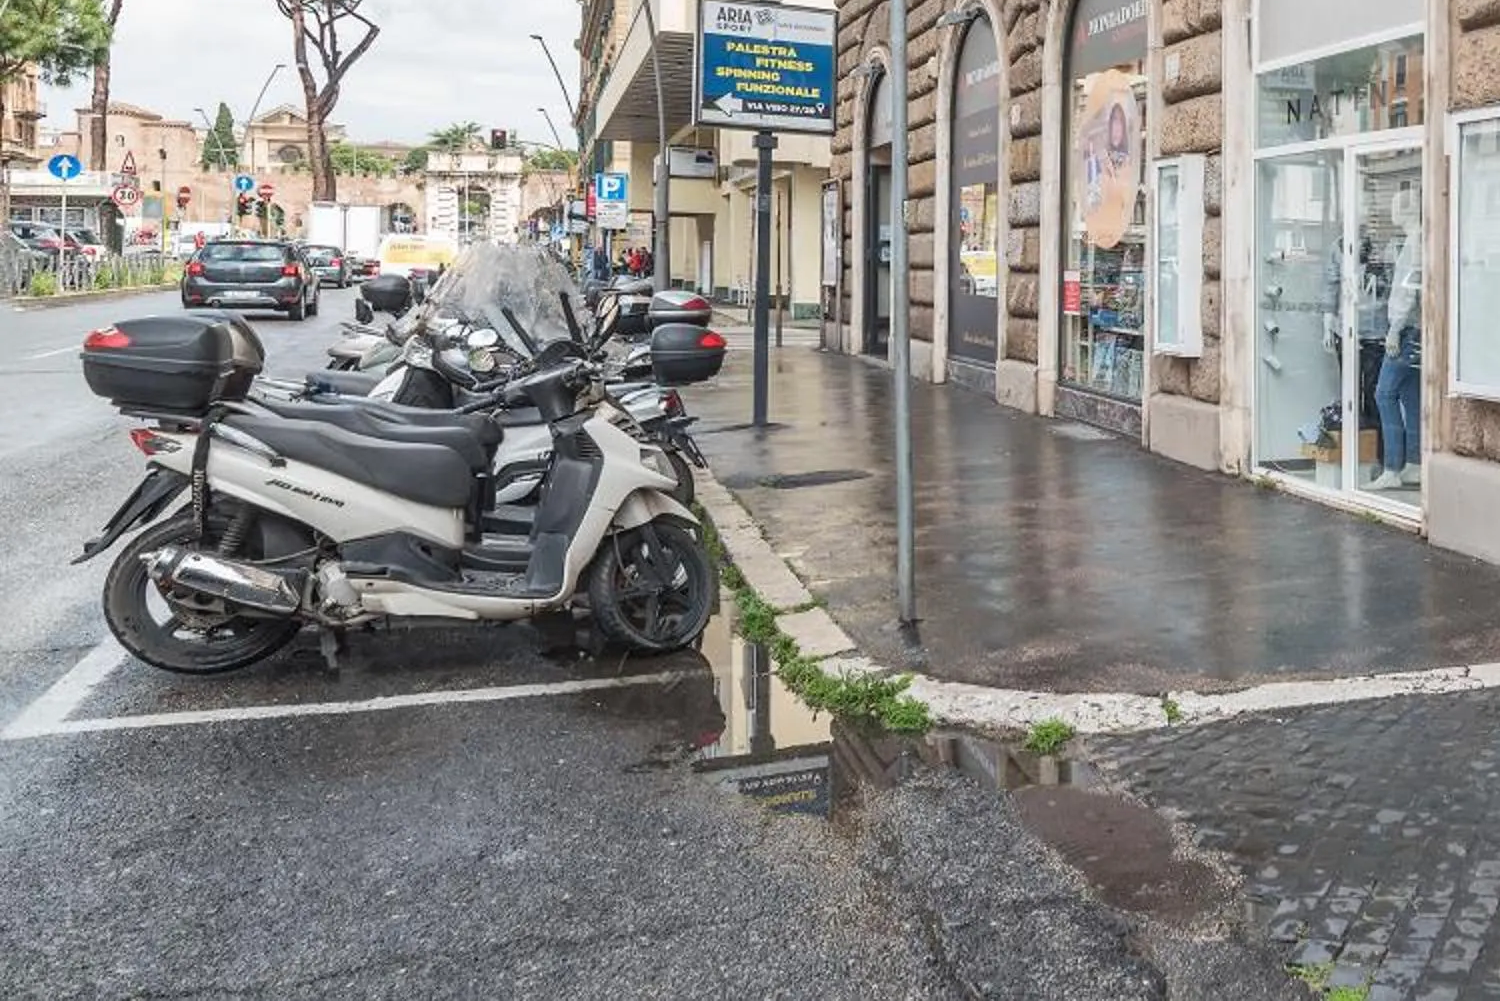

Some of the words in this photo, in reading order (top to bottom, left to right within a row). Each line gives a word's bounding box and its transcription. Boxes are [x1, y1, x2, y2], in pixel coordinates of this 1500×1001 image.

[717, 6, 753, 24] ARIA
[726, 42, 798, 58] PALESTRA
[756, 56, 815, 73] FITNESS
[715, 66, 781, 82] SPINNING
[736, 82, 821, 98] FUNZIONALE
[747, 102, 763, 111] VIA
[120, 190, 135, 201] 30
[601, 178, 622, 200] P
